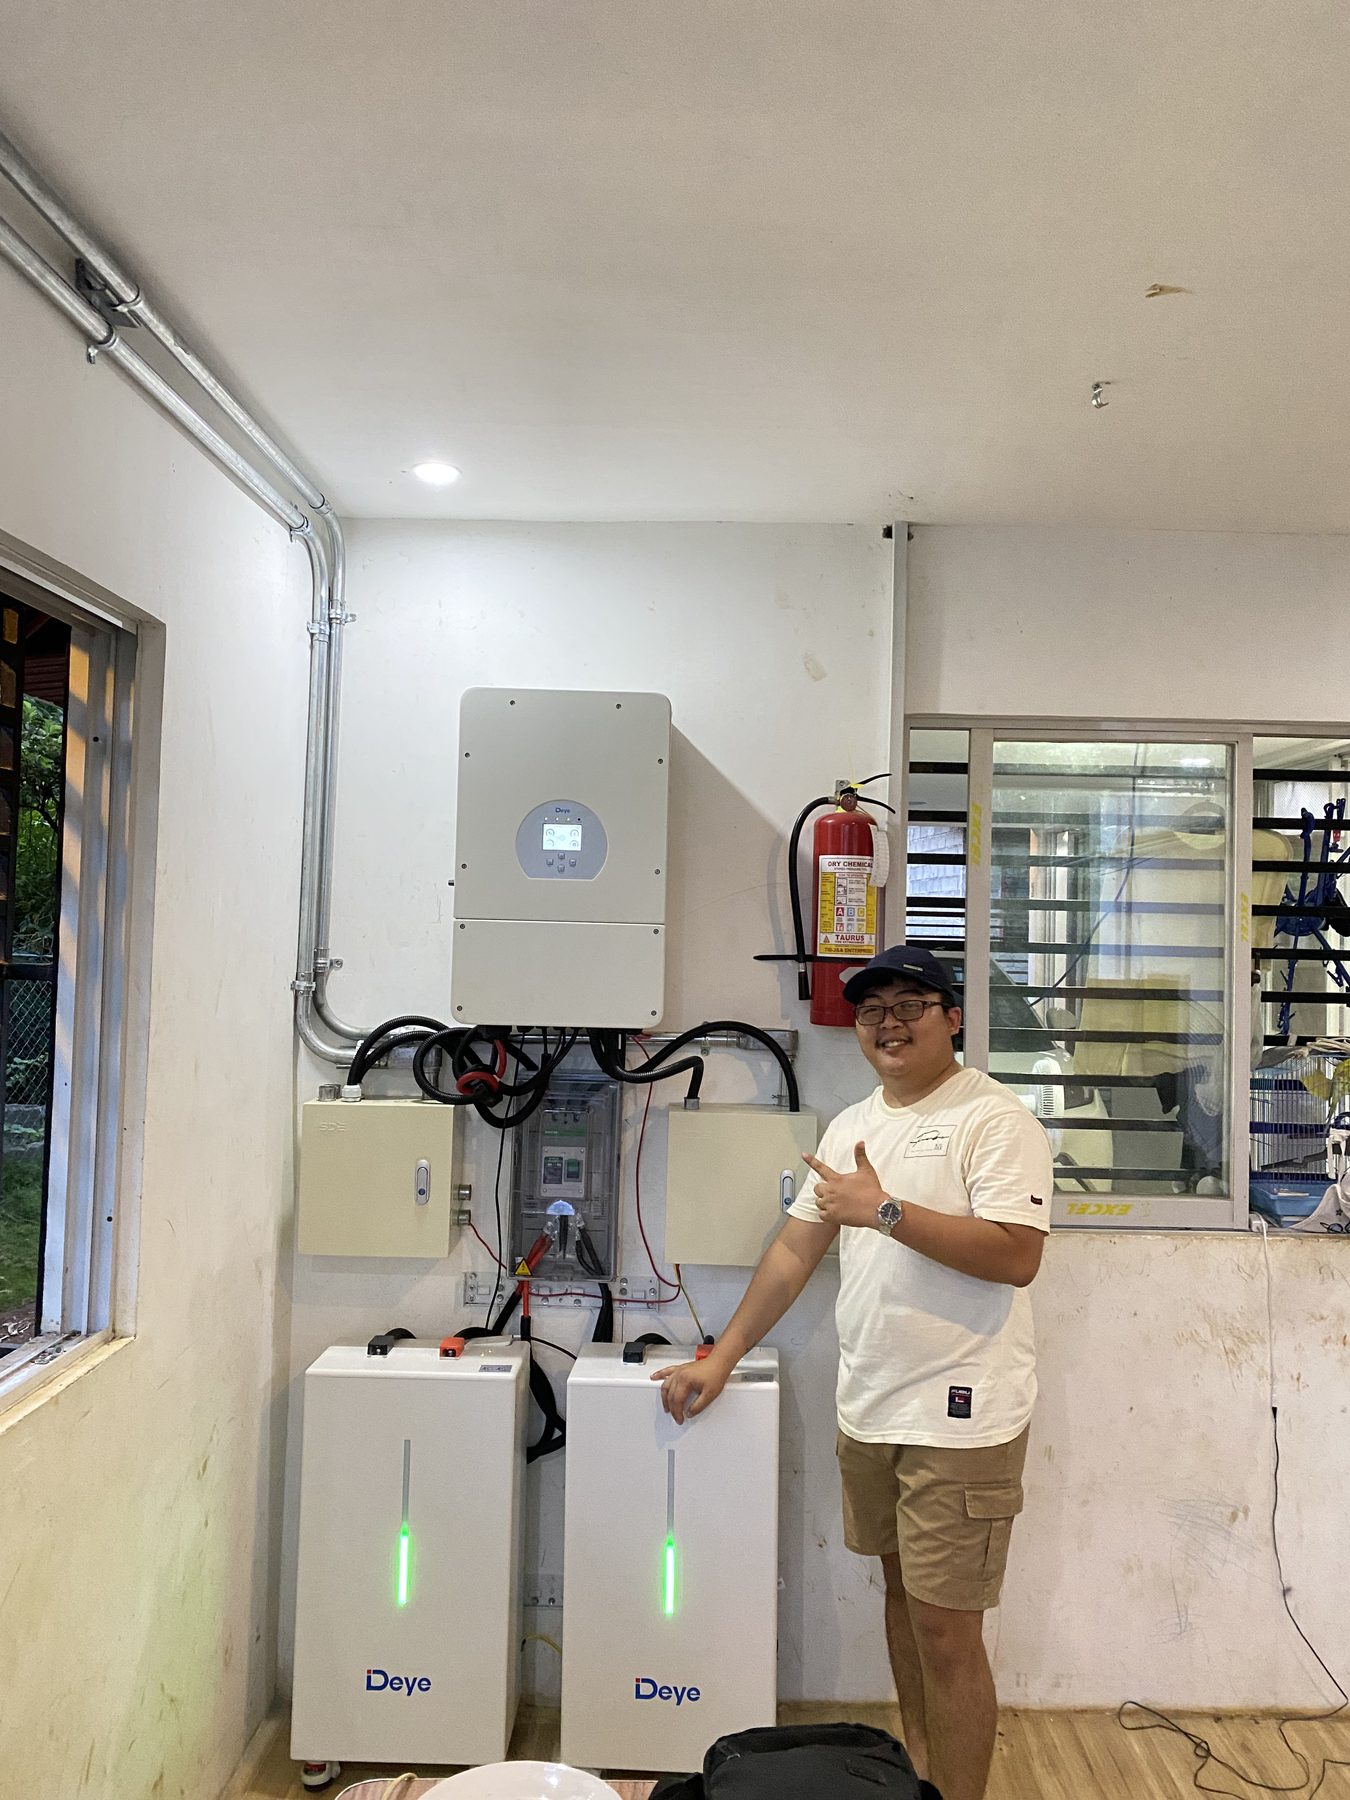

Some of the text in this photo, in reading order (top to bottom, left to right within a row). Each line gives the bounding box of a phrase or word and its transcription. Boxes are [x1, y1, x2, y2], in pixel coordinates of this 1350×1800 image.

[835, 934, 865, 942] TAURUS
[366, 1669, 432, 1697] Deye
[635, 1678, 701, 1706] Deye
